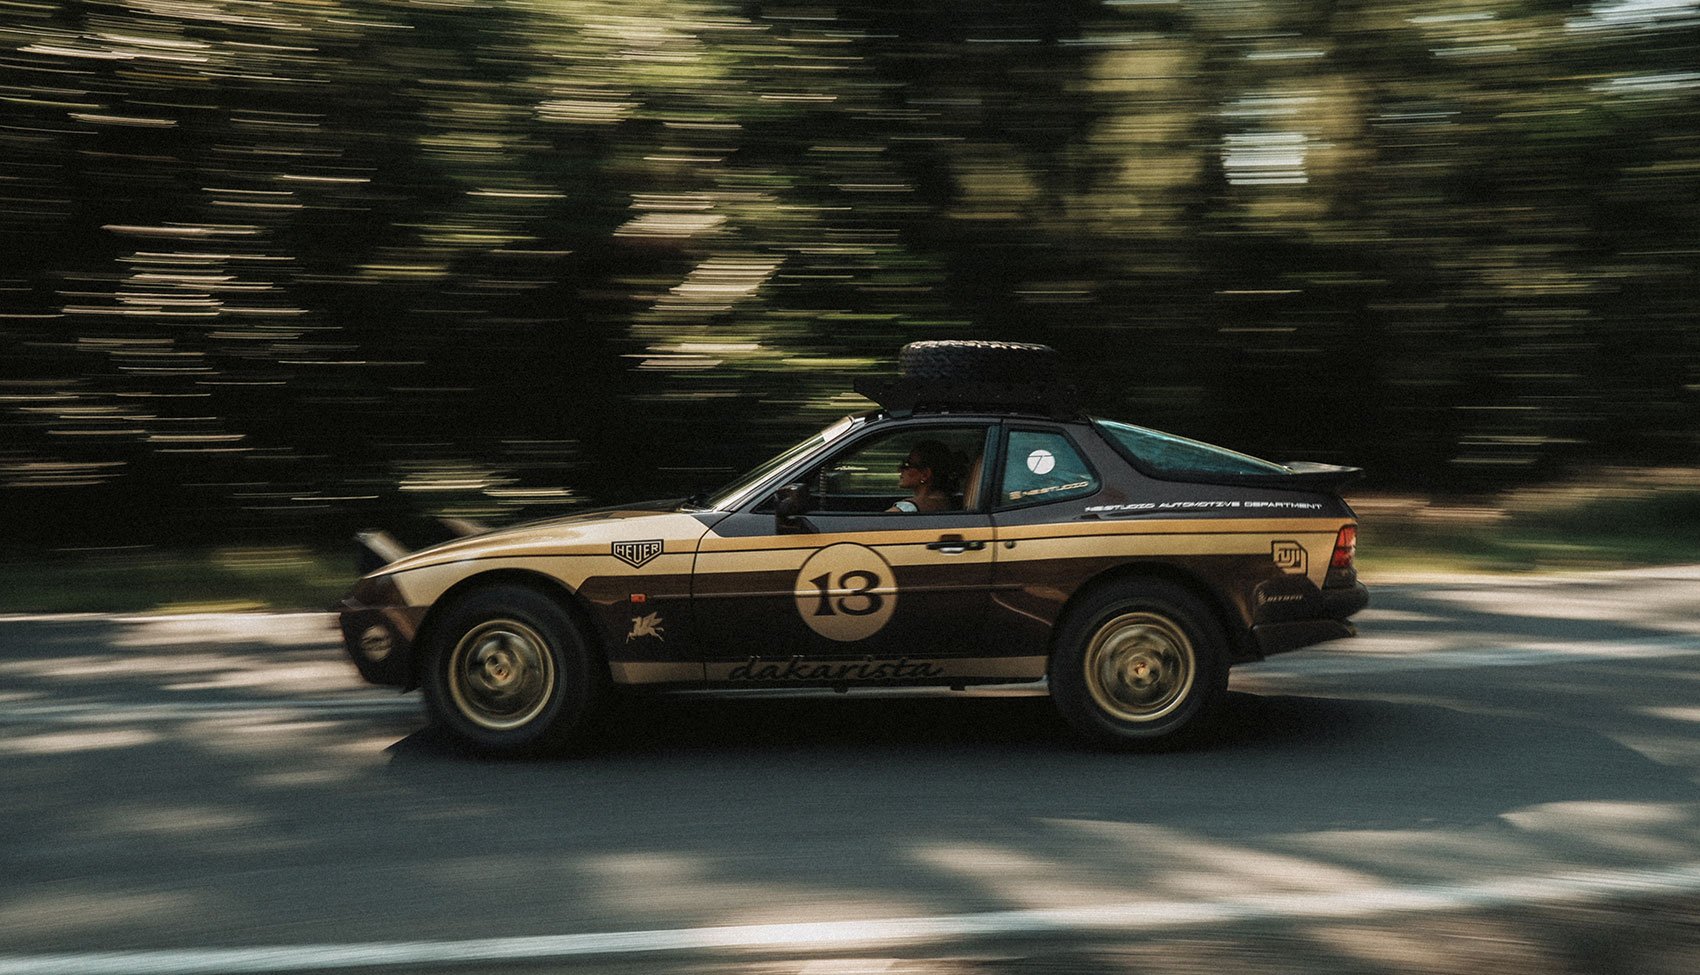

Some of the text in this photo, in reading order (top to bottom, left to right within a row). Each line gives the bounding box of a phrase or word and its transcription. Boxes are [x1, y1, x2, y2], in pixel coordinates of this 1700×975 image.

[1244, 501, 1322, 509] DEPARTMENT
[616, 543, 659, 563] HEUER
[809, 570, 884, 616] 13
[729, 655, 944, 680] dakarista
